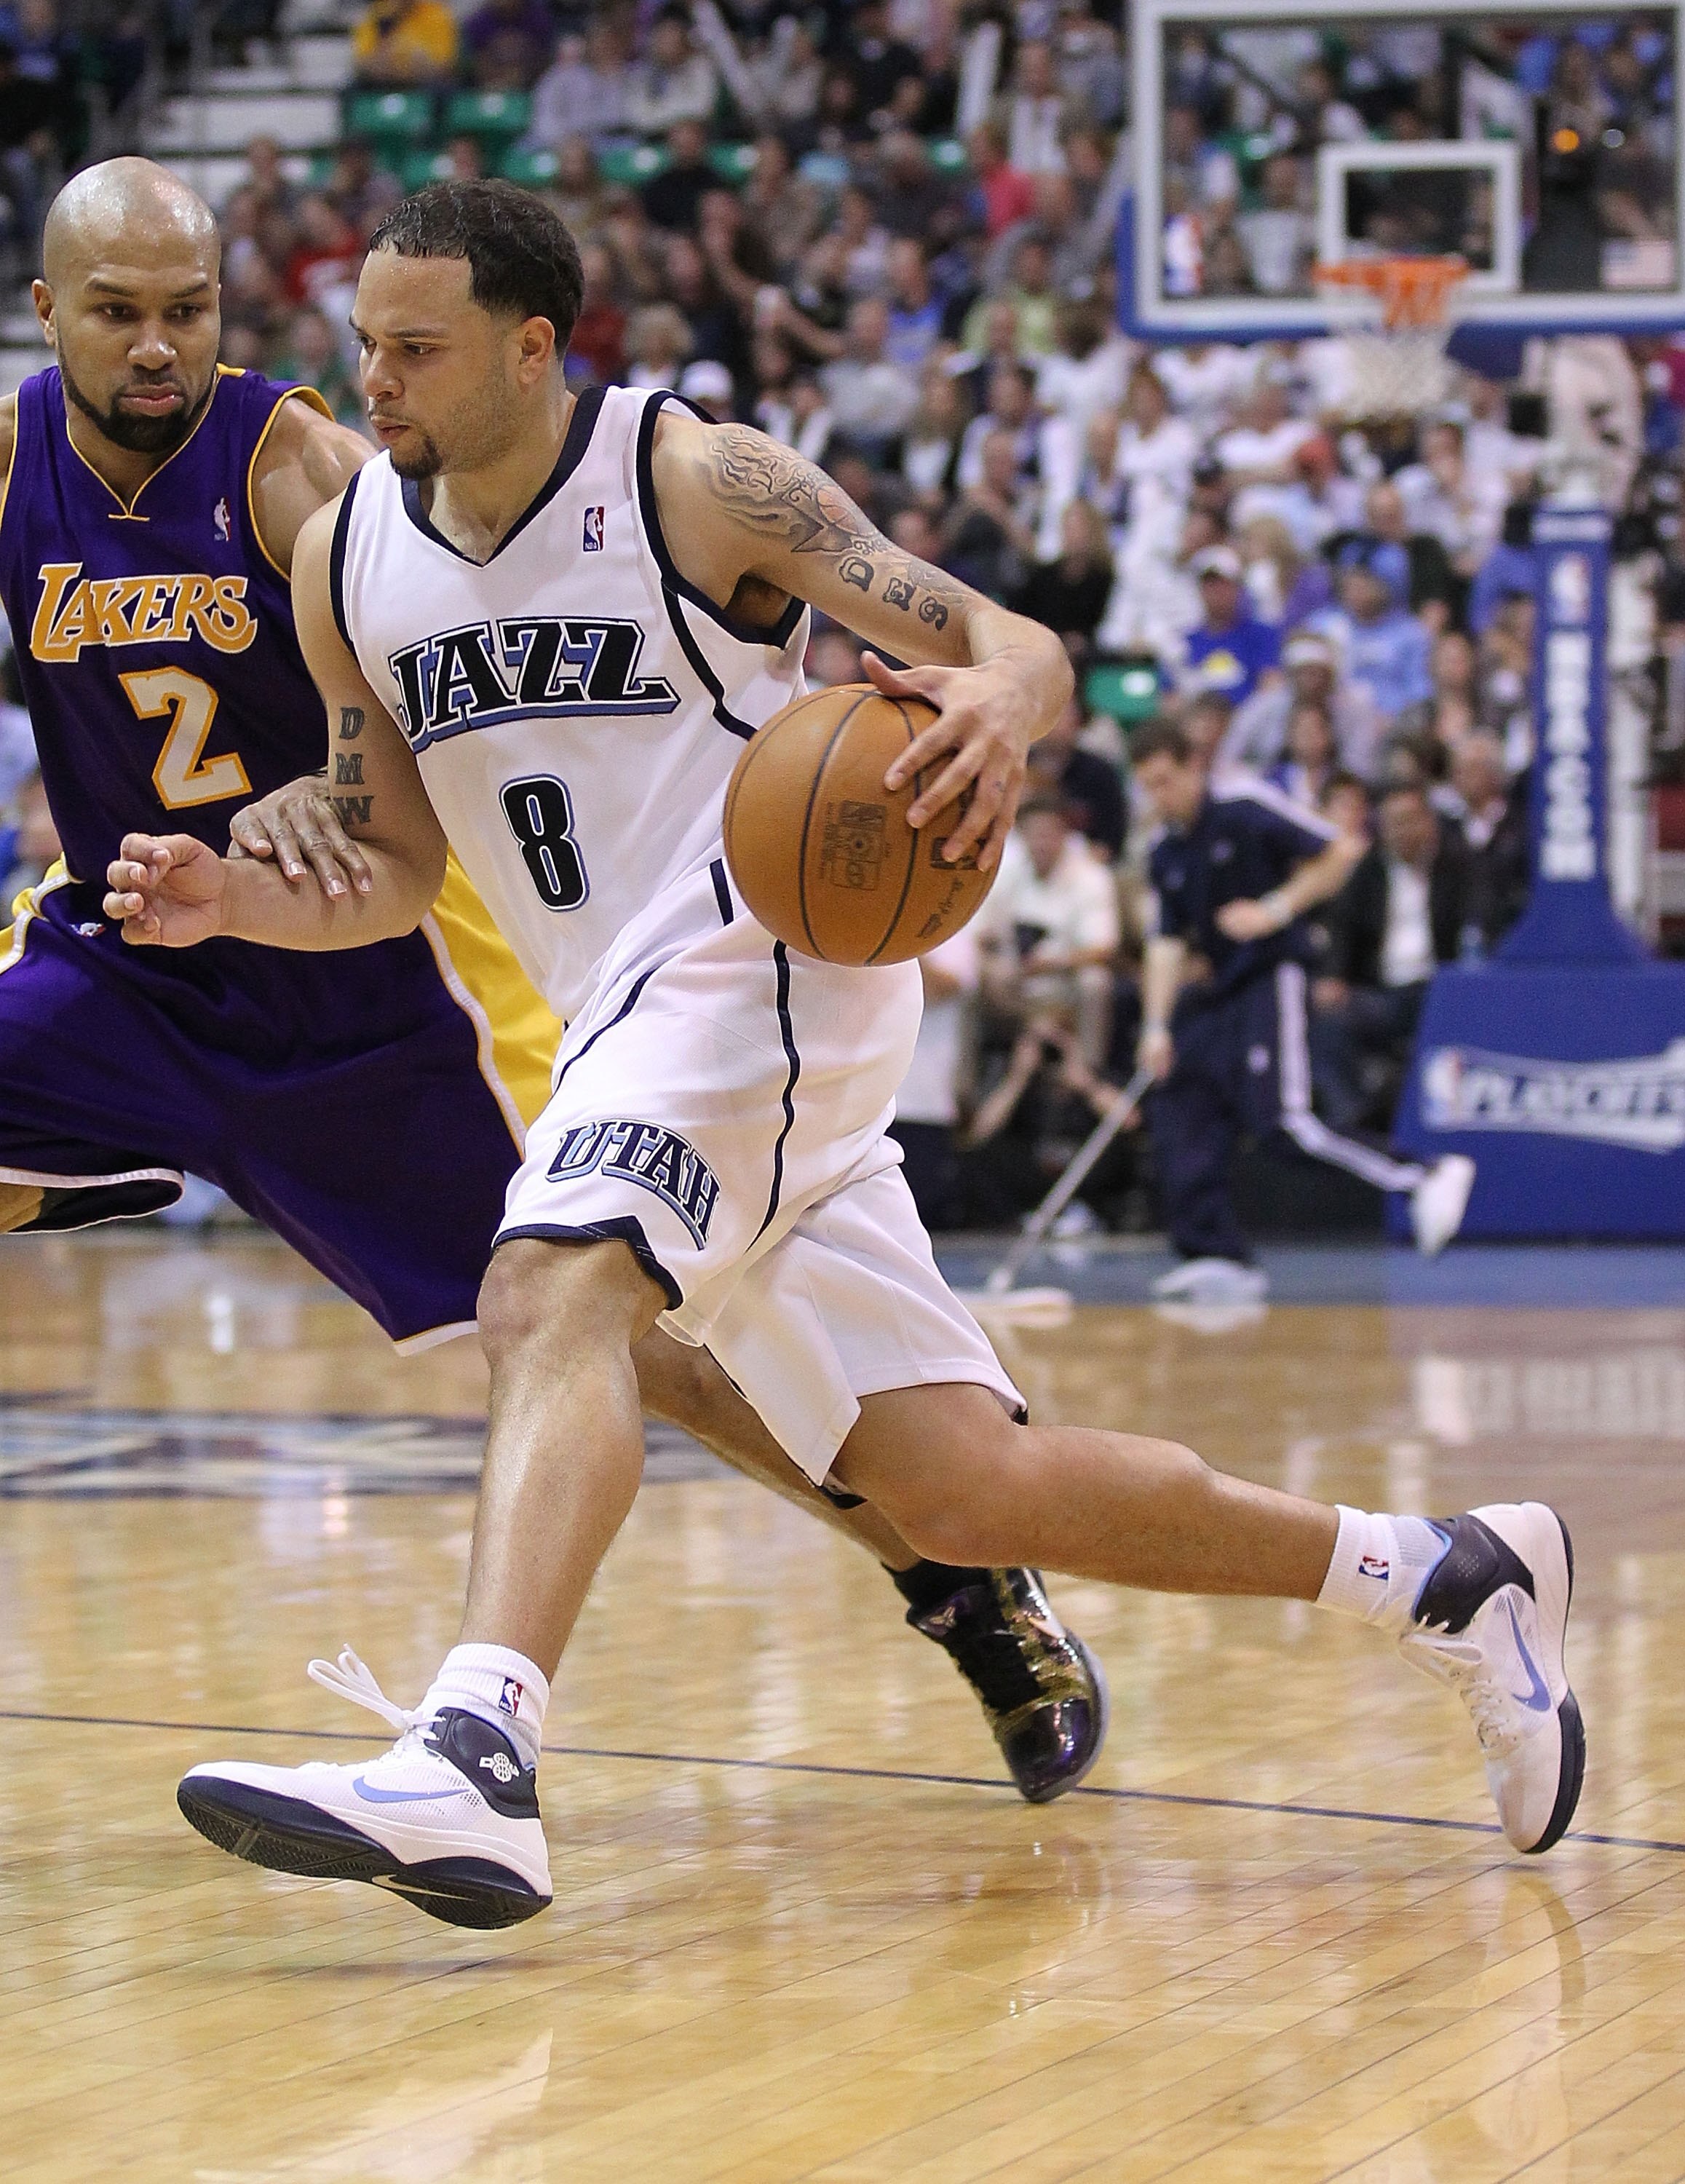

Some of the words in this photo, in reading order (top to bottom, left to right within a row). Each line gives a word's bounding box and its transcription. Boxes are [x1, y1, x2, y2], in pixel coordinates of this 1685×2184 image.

[30, 562, 258, 663] LAKERS
[584, 542, 598, 550] NBA
[118, 665, 253, 810] 2
[388, 615, 681, 755] JAZZ
[499, 773, 590, 912] 8
[545, 1117, 723, 1251] UTAH
